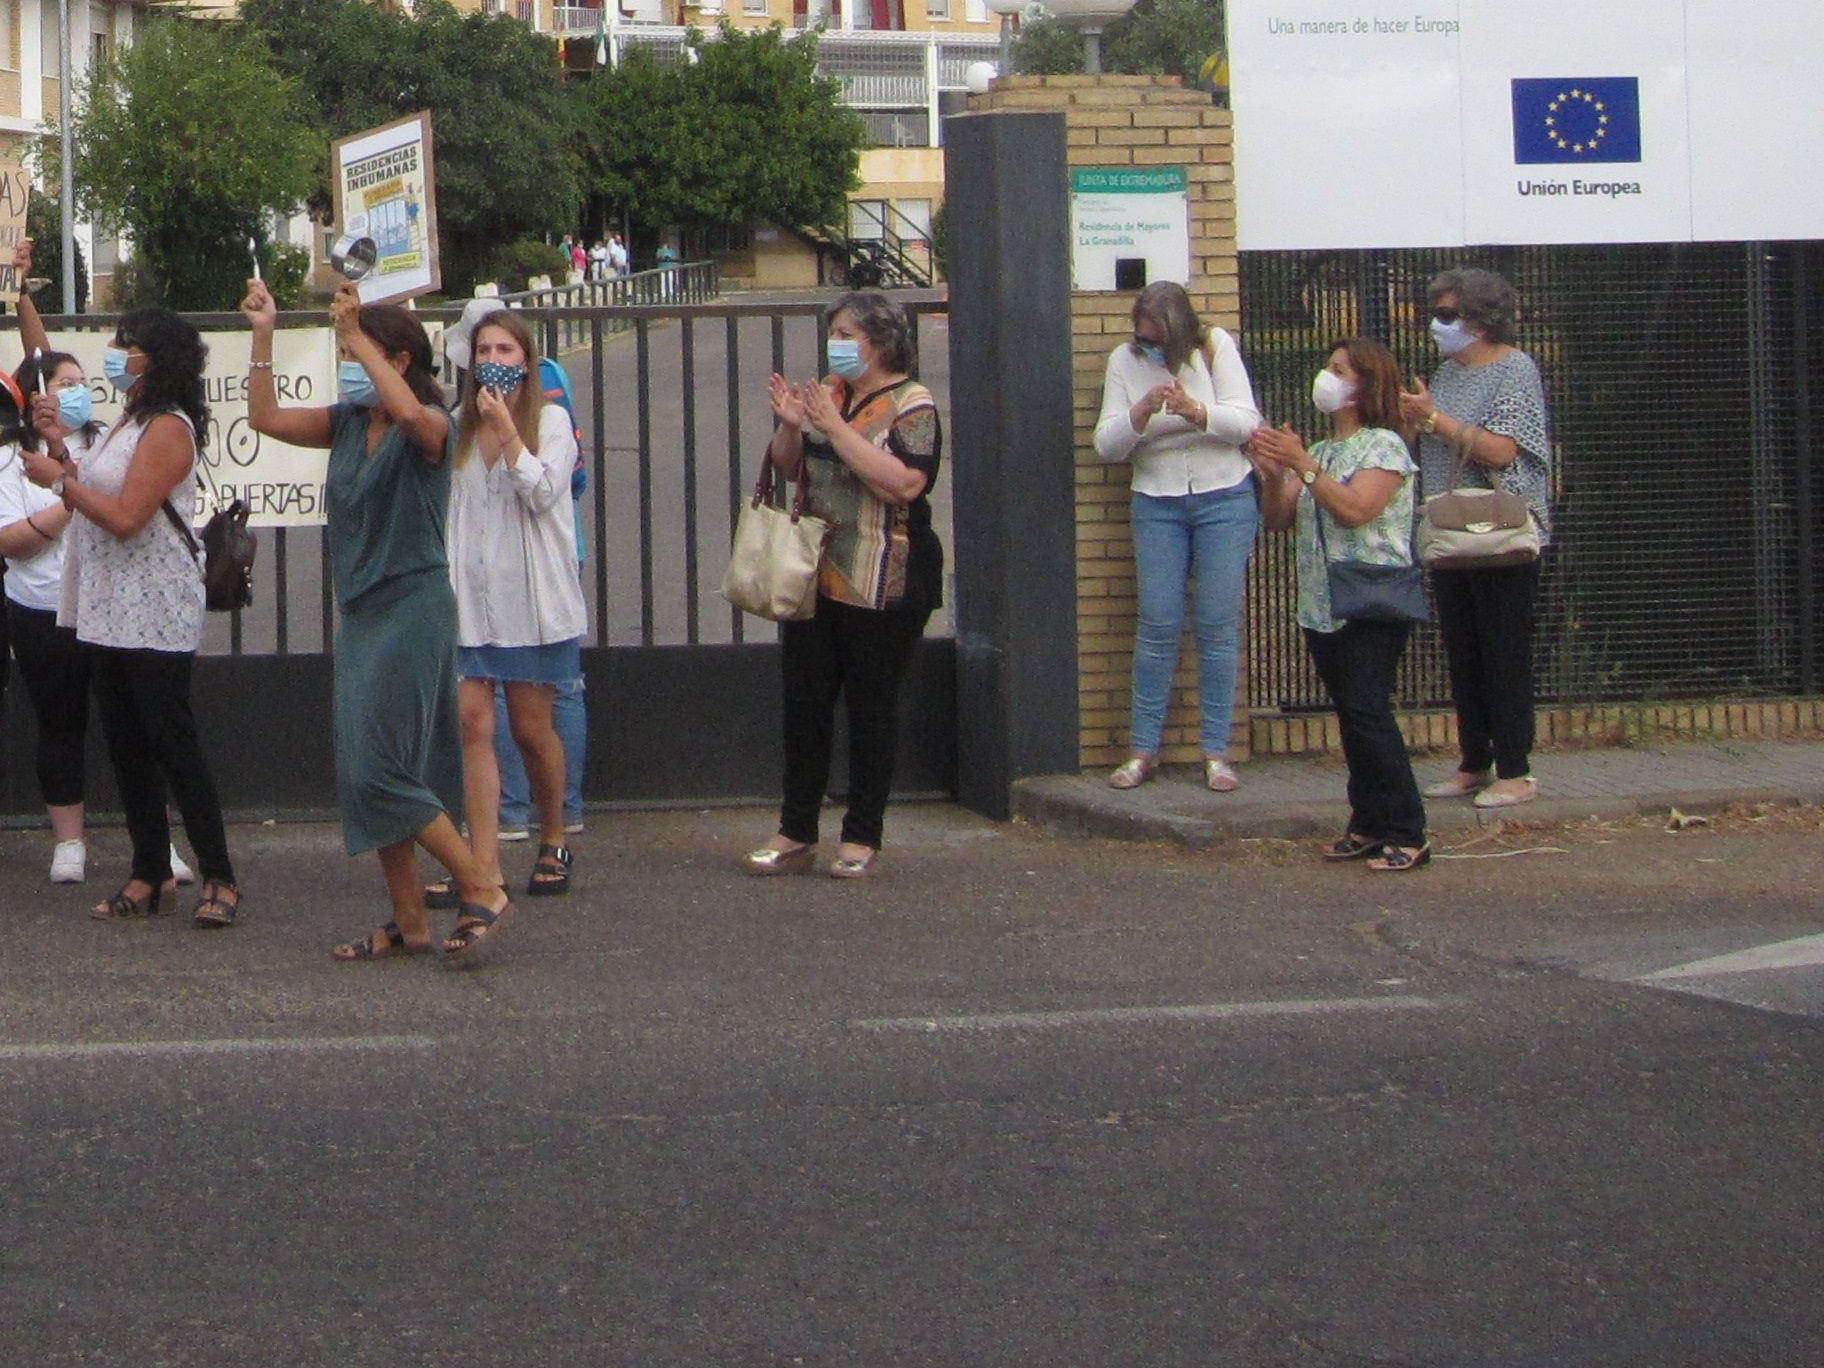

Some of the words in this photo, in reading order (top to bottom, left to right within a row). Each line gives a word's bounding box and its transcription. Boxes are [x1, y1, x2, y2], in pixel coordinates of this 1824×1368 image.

[1268, 18, 1295, 35] Una
[1300, 20, 1347, 34] manera
[1352, 17, 1369, 34] de
[1373, 16, 1410, 33] hacer
[1414, 16, 1460, 37] Europa
[346, 145, 417, 179] RESIDENCIAS
[347, 158, 418, 193] INHUMANAS
[1517, 179, 1568, 196] Unión
[1572, 179, 1642, 199] Europea
[1079, 221, 1122, 231] Residencia
[1124, 221, 1134, 231] de
[1136, 221, 1170, 233] Mayores
[1079, 236, 1090, 246] La
[1091, 235, 1134, 246] Granadilla
